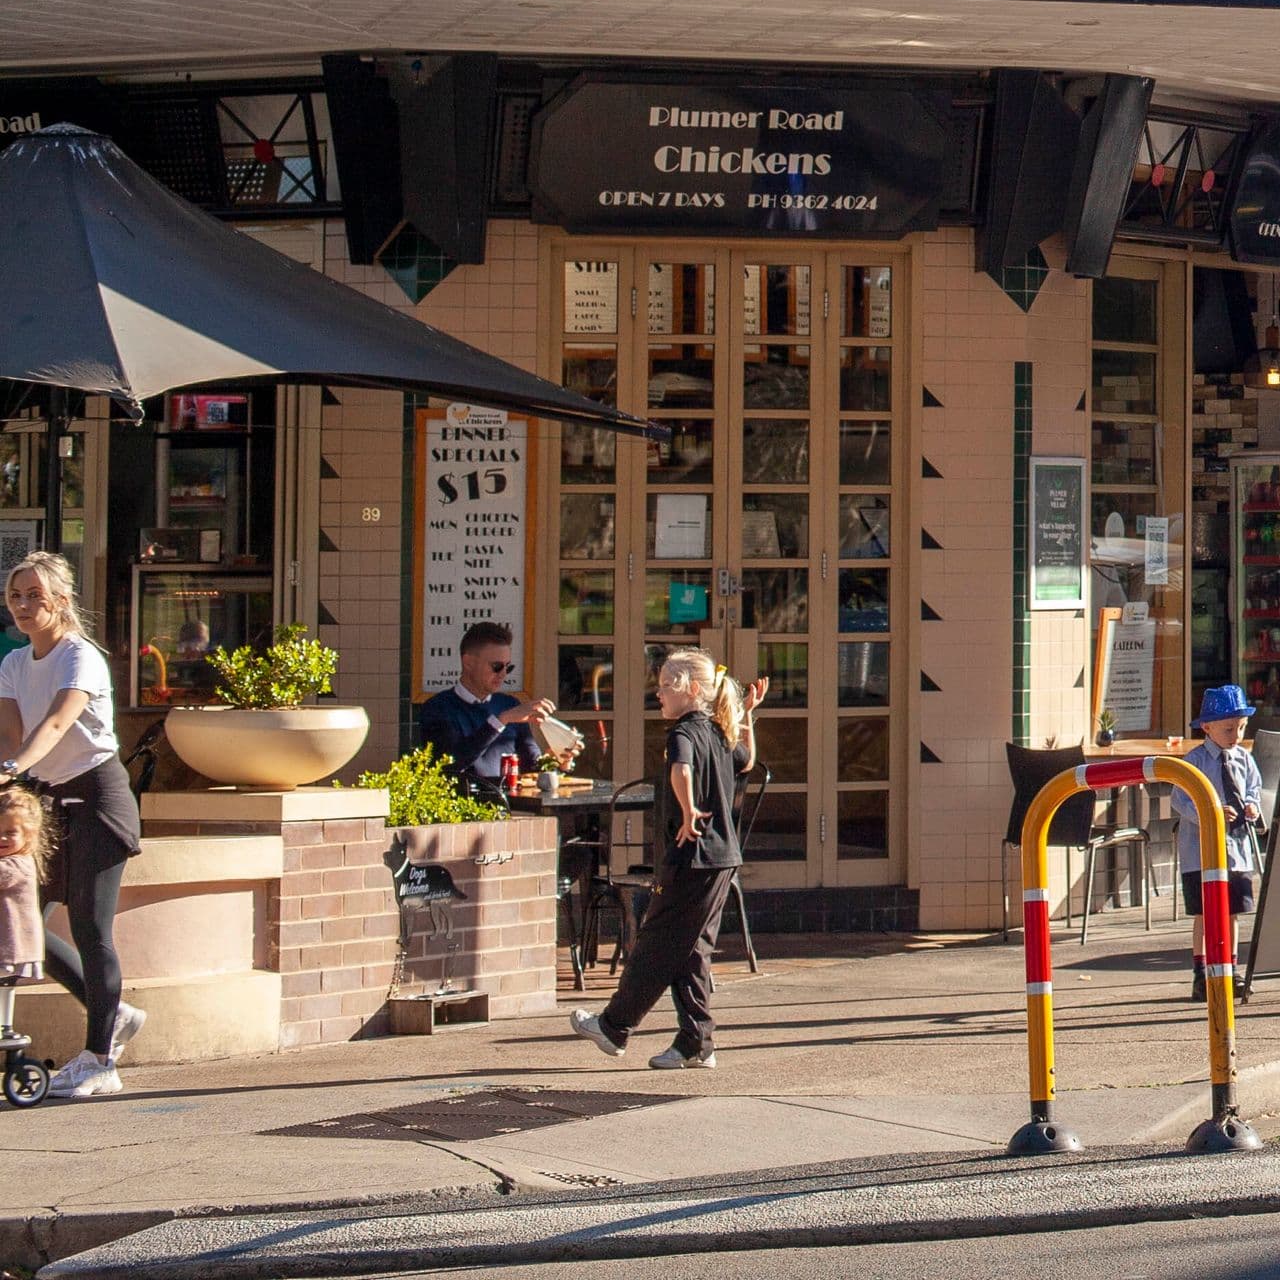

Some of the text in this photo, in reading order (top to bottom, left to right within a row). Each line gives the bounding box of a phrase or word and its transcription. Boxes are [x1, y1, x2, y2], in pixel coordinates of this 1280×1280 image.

[0, 112, 41, 134] oad
[649, 106, 843, 131] Plumer Road
[654, 145, 831, 175] Chickens
[599, 191, 877, 210] OPEN 7 DAYS PH 9362 4024
[441, 427, 511, 441] DINNER
[431, 448, 520, 462] SPECIALS
[437, 467, 507, 507] $15
[361, 507, 381, 521] 89
[429, 512, 520, 529] MON CHICKEN
[466, 527, 515, 536] BURGER
[432, 545, 504, 561] TUE PASTA
[464, 559, 494, 568] NITE
[428, 584, 457, 593] WED
[464, 591, 498, 600] SLAW
[430, 609, 493, 625] THU BEEF
[431, 648, 452, 657] FRI
[409, 867, 427, 883] Dogs
[399, 883, 429, 896] Welcome
